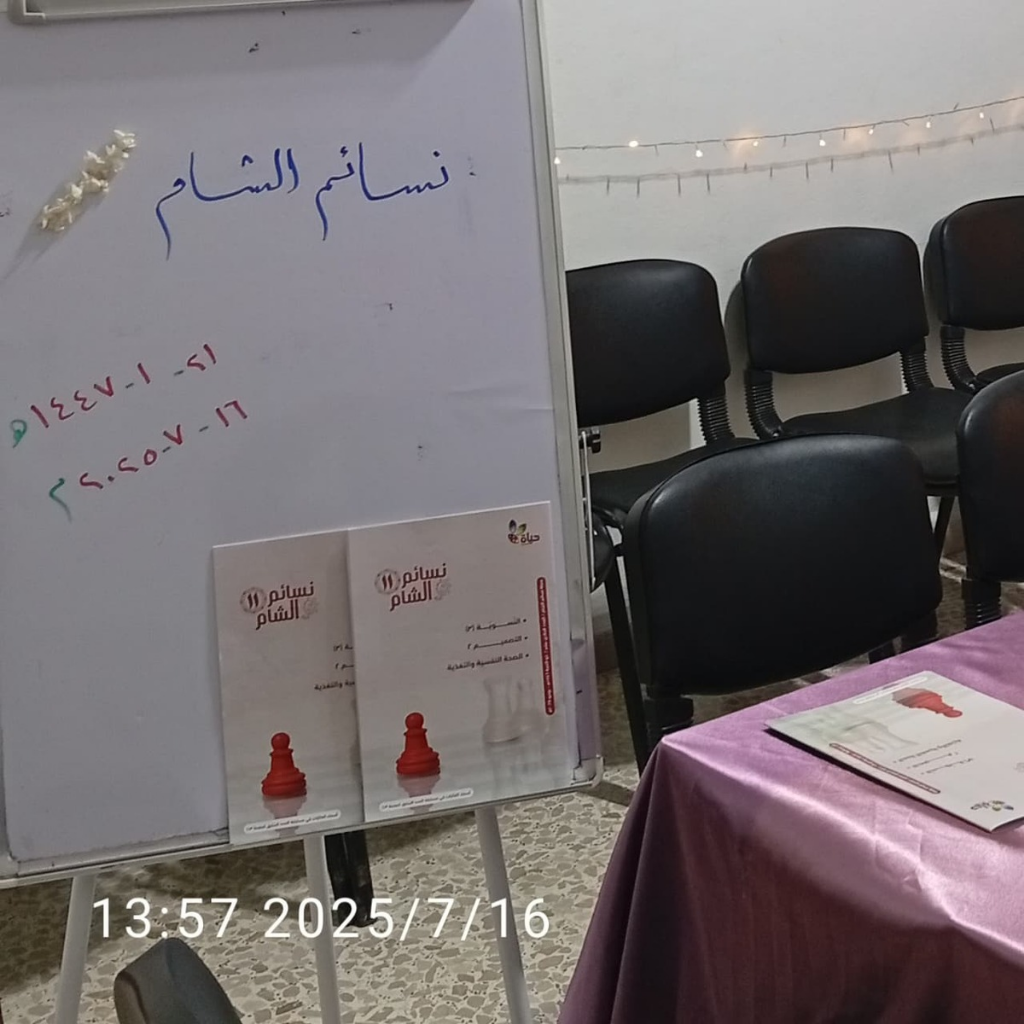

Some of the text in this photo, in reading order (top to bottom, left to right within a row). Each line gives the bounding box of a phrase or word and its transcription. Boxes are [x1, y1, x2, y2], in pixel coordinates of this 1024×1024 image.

[155, 142, 450, 261] نسائم الشام
[401, 562, 447, 589] نسائم
[267, 581, 315, 608] نسائم
[389, 580, 432, 612] الشام
[255, 599, 300, 631] الشام
